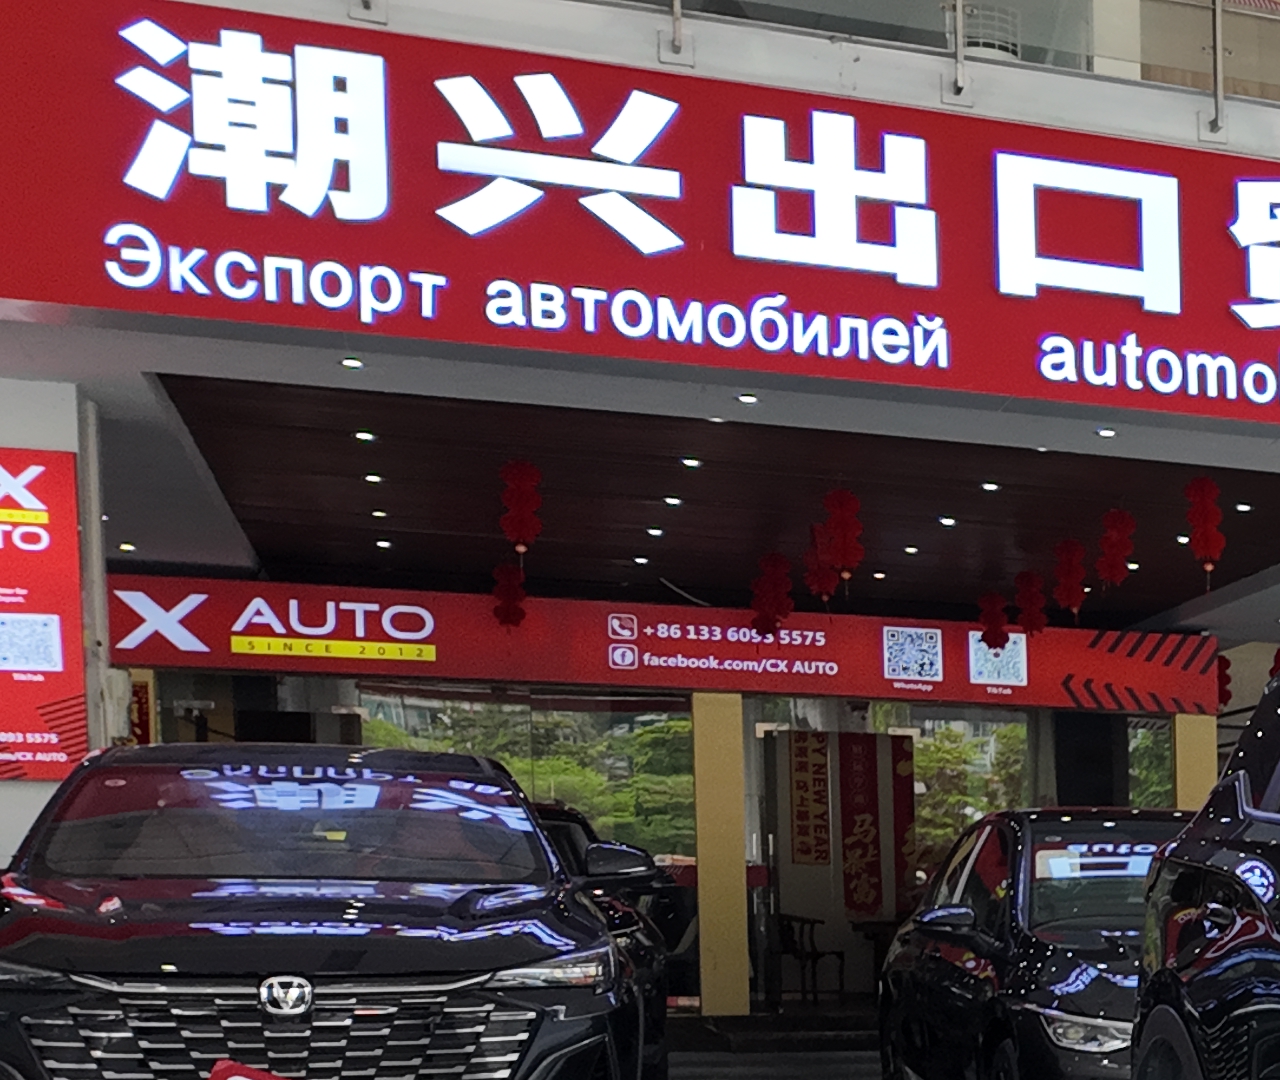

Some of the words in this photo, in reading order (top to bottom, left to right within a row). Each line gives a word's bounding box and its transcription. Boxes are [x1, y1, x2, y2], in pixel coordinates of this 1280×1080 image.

[103, 222, 449, 324] Экспорт
[485, 277, 949, 369] автомобилей
[231, 597, 435, 640] AUTO
[643, 623, 682, 639] +86
[686, 625, 722, 640] 133
[779, 629, 826, 646] 5575
[247, 640, 333, 654] SINCE
[358, 645, 424, 658] 2012
[643, 652, 789, 674] facebook.com/CX
[792, 661, 839, 675] AUTO
